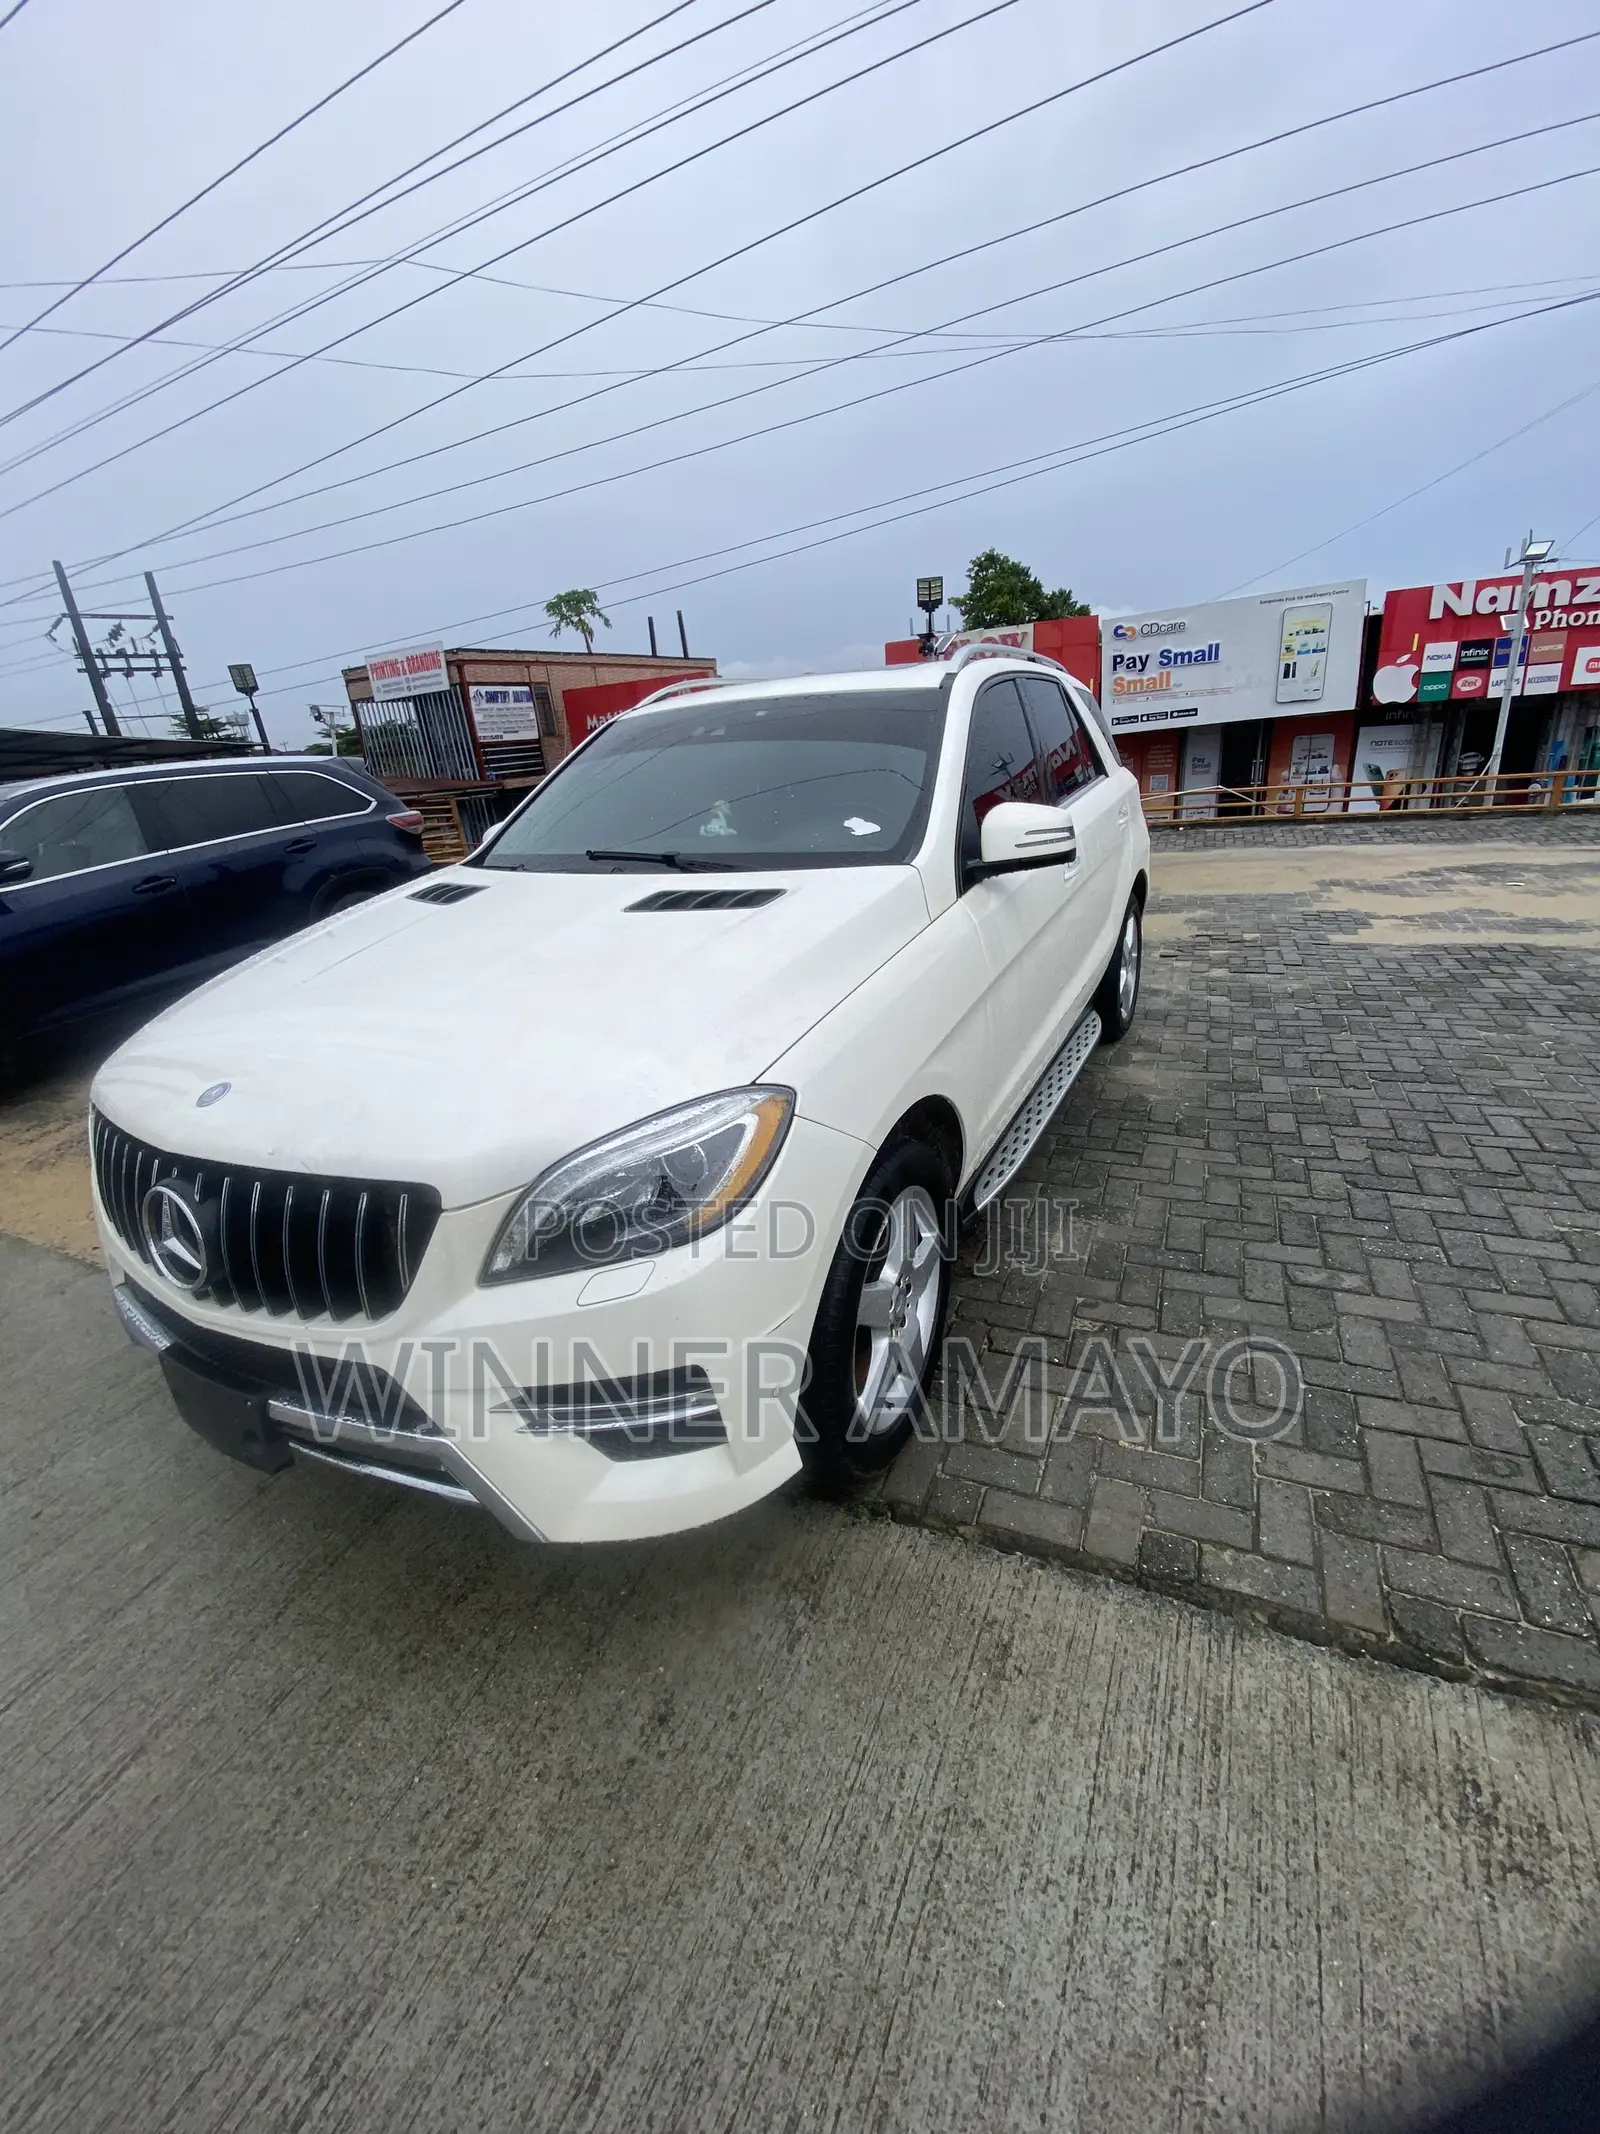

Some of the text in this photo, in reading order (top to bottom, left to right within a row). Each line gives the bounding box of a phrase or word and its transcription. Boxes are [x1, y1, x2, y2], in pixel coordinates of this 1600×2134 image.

[1140, 621, 1187, 635] CDcare
[1112, 643, 1220, 672] Pay Small
[1112, 671, 1171, 695] Small
